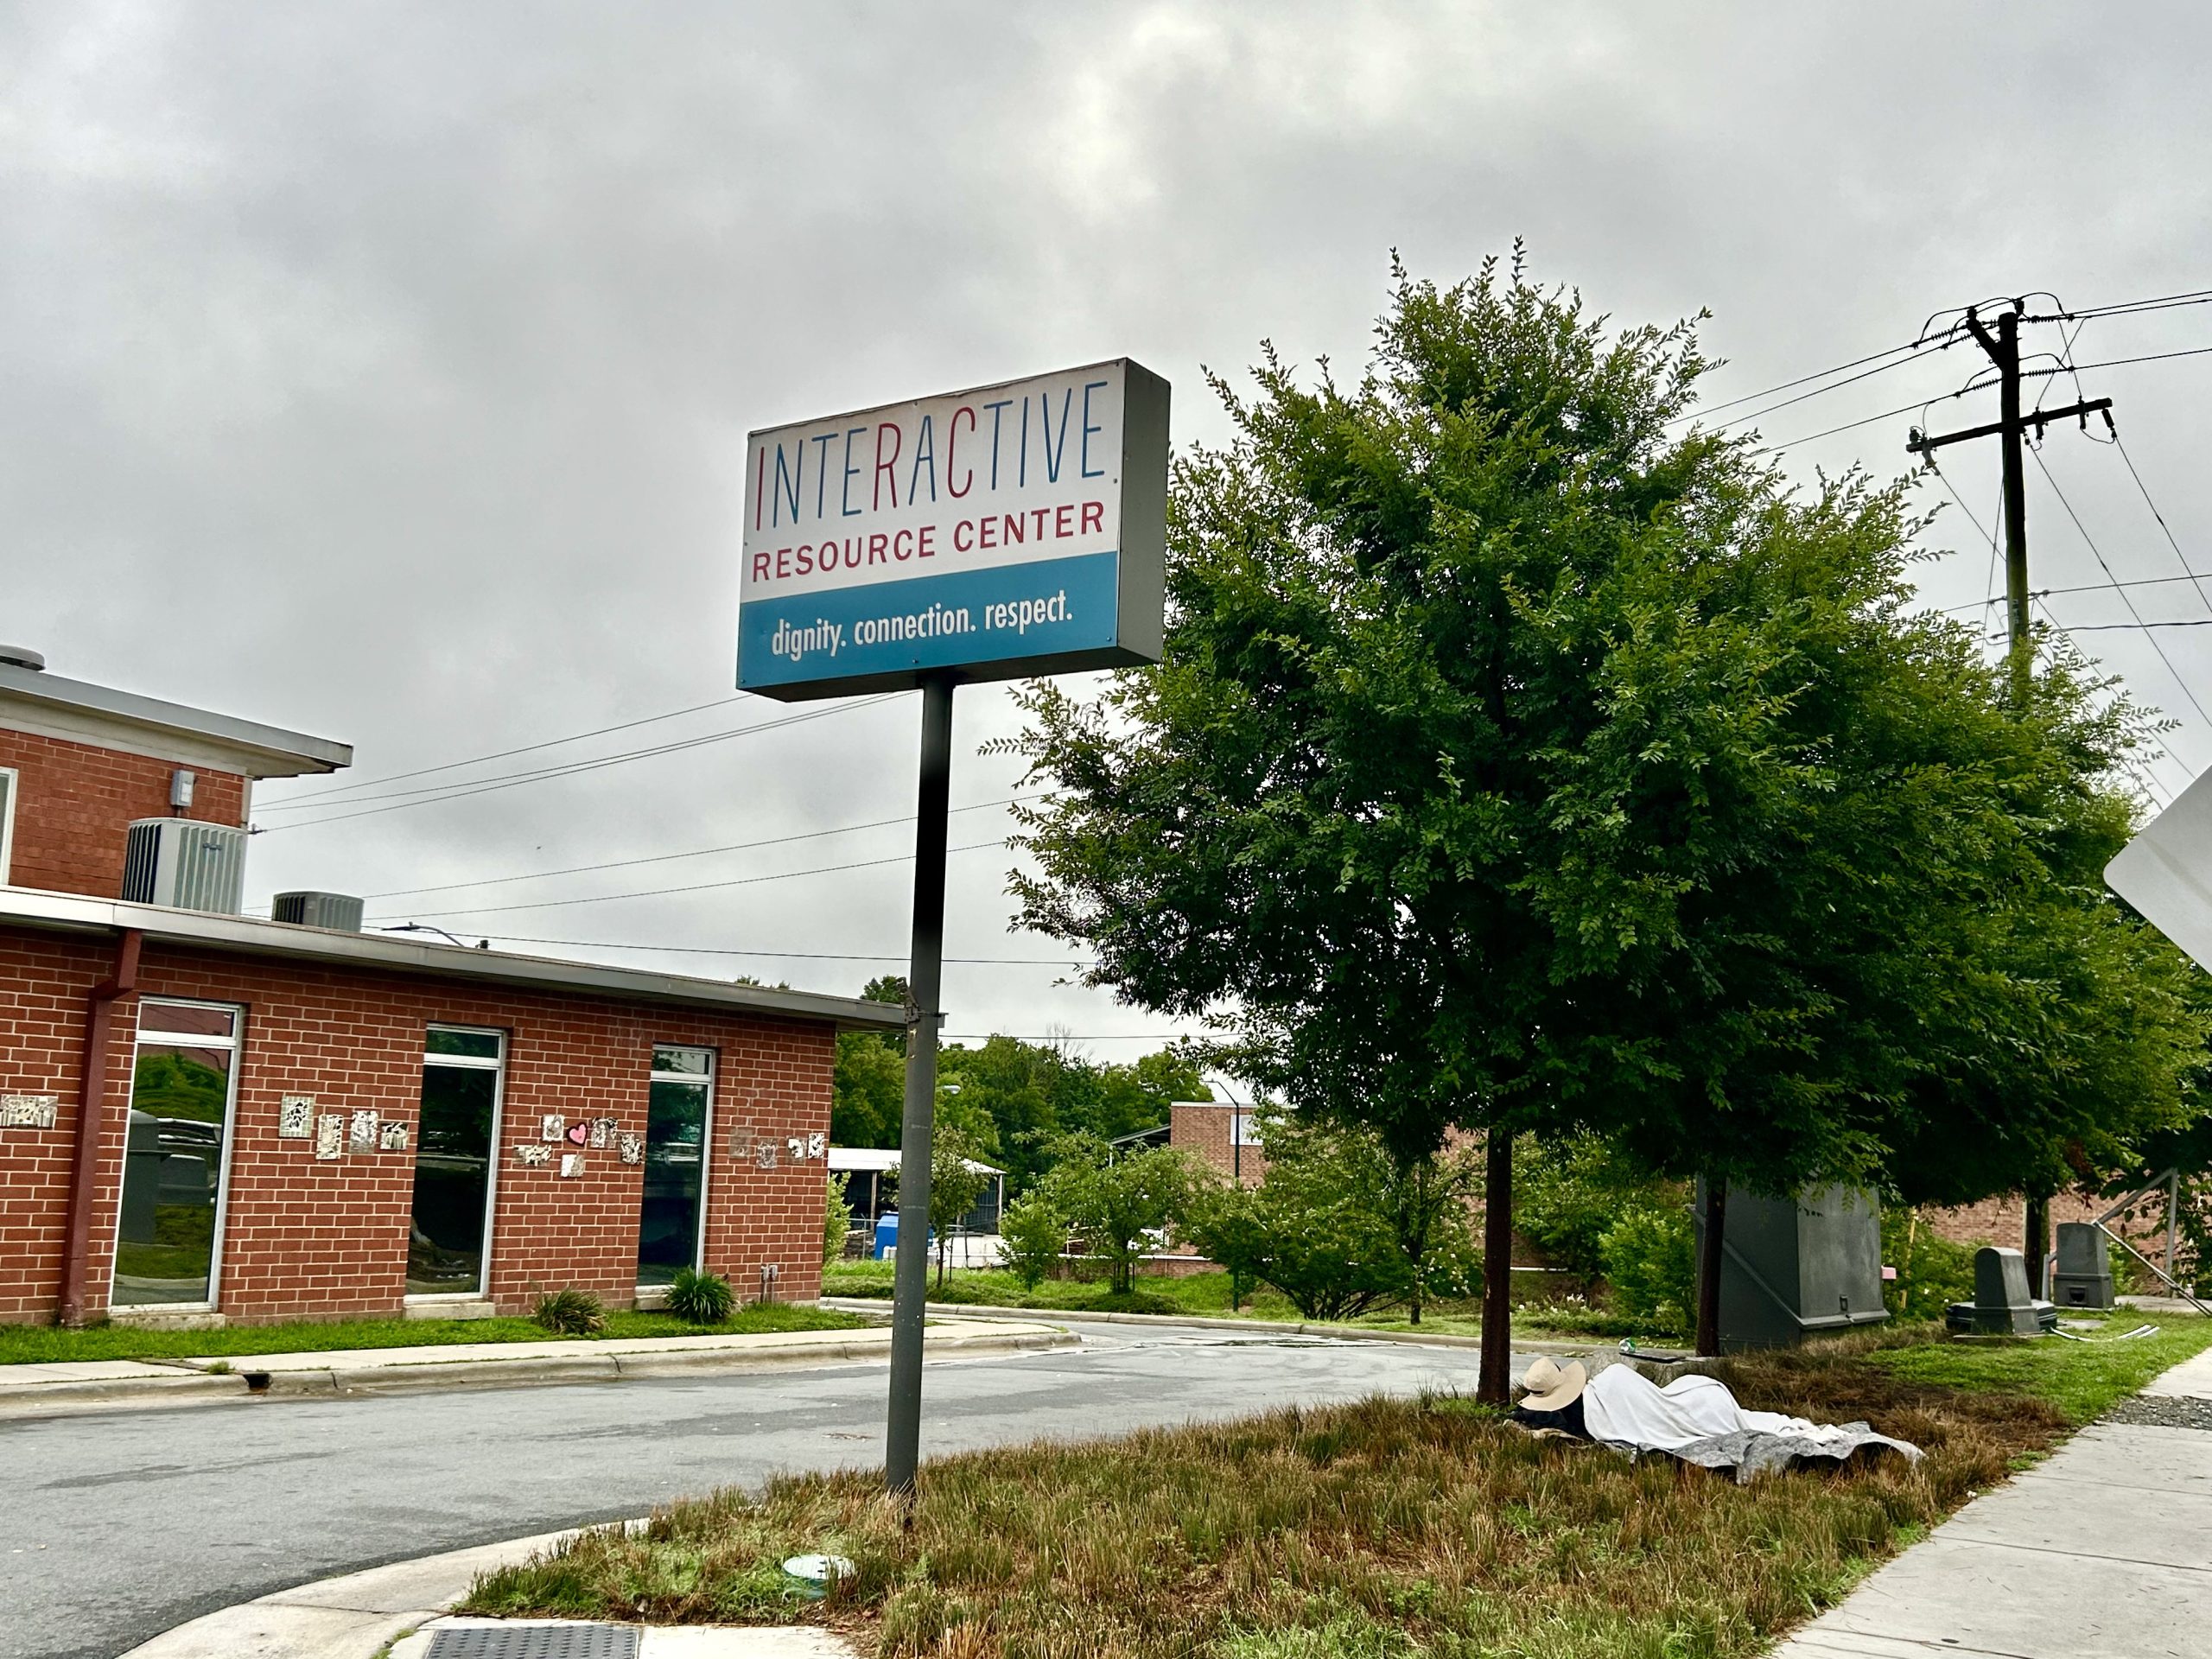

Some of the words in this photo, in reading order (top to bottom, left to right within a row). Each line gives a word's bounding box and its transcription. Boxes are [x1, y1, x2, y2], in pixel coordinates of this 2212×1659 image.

[756, 381, 1109, 531] INTERACTIVE
[753, 525, 936, 582] RESOURCE
[953, 501, 1104, 552] CENTER
[772, 619, 847, 662] dignity.
[855, 603, 976, 645] connection.
[985, 590, 1072, 634] respect.
